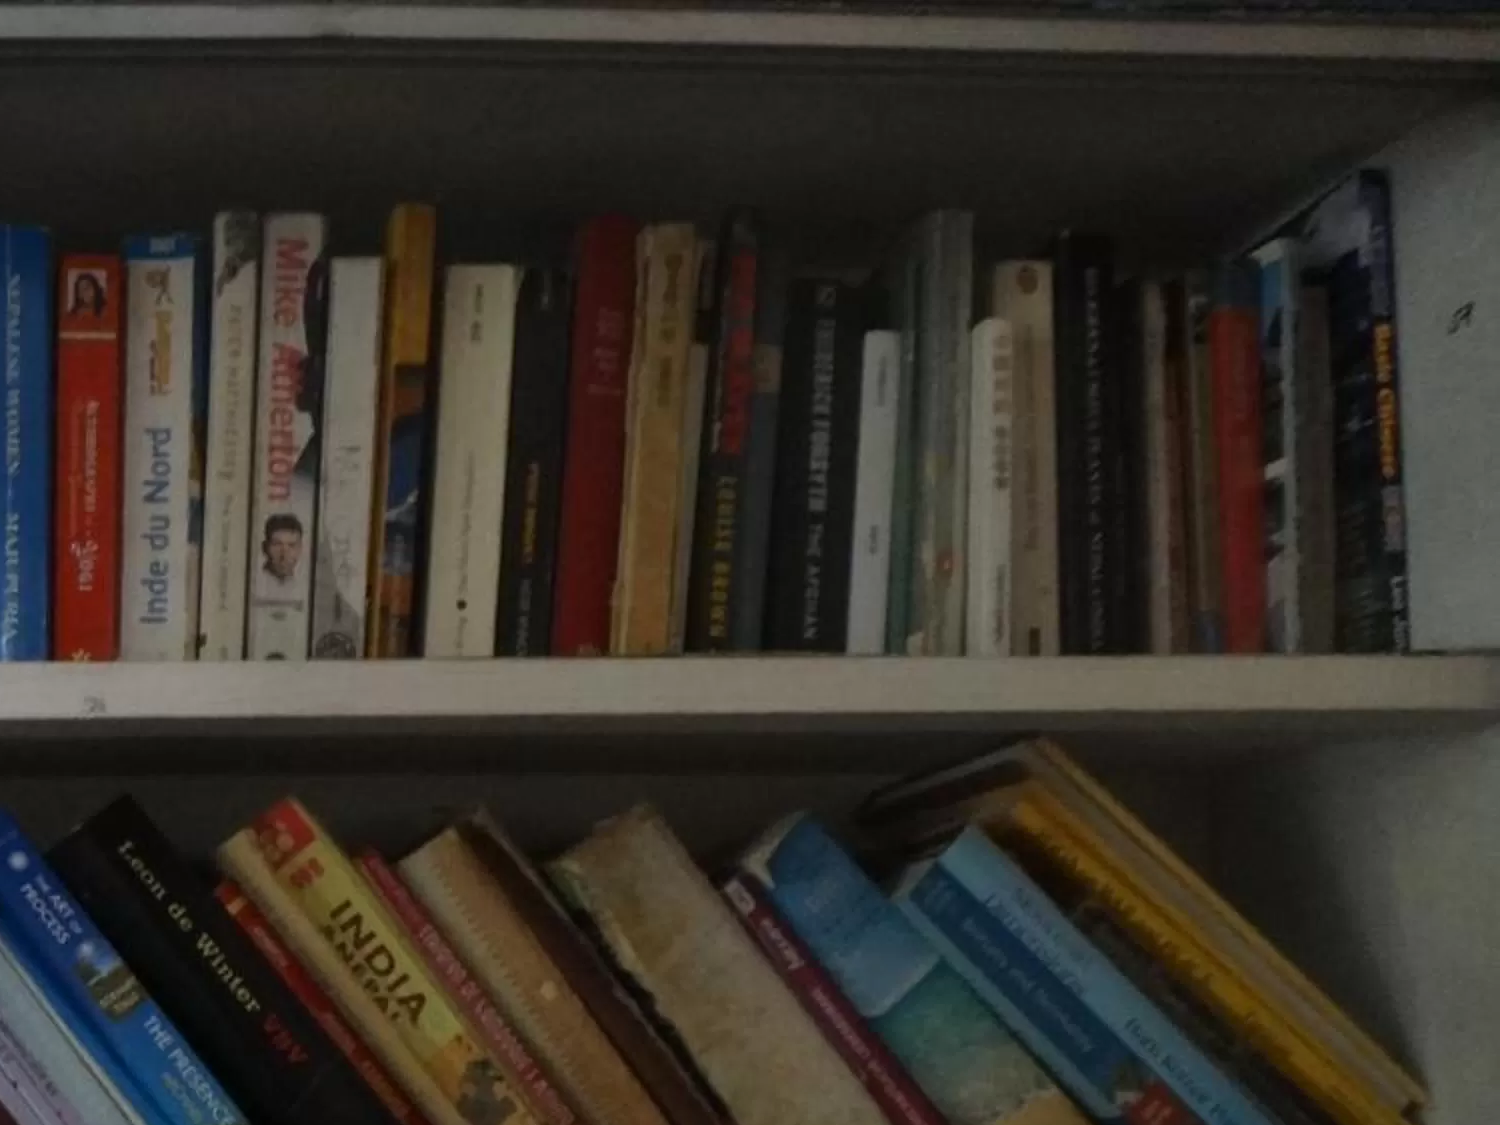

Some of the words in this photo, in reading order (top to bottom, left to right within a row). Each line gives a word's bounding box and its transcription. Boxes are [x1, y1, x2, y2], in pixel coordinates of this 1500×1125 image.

[269, 236, 306, 327] Mike
[260, 343, 305, 501] Atherton
[142, 426, 171, 503] Nord
[140, 521, 168, 550] du
[139, 561, 168, 624] Inde
[18, 878, 73, 949] PROCESS
[46, 889, 75, 921] ART
[113, 837, 173, 901] Leon
[164, 898, 199, 935] de
[187, 929, 269, 1017] Winter
[328, 899, 431, 1028] INDIA
[140, 1013, 176, 1051] THE
